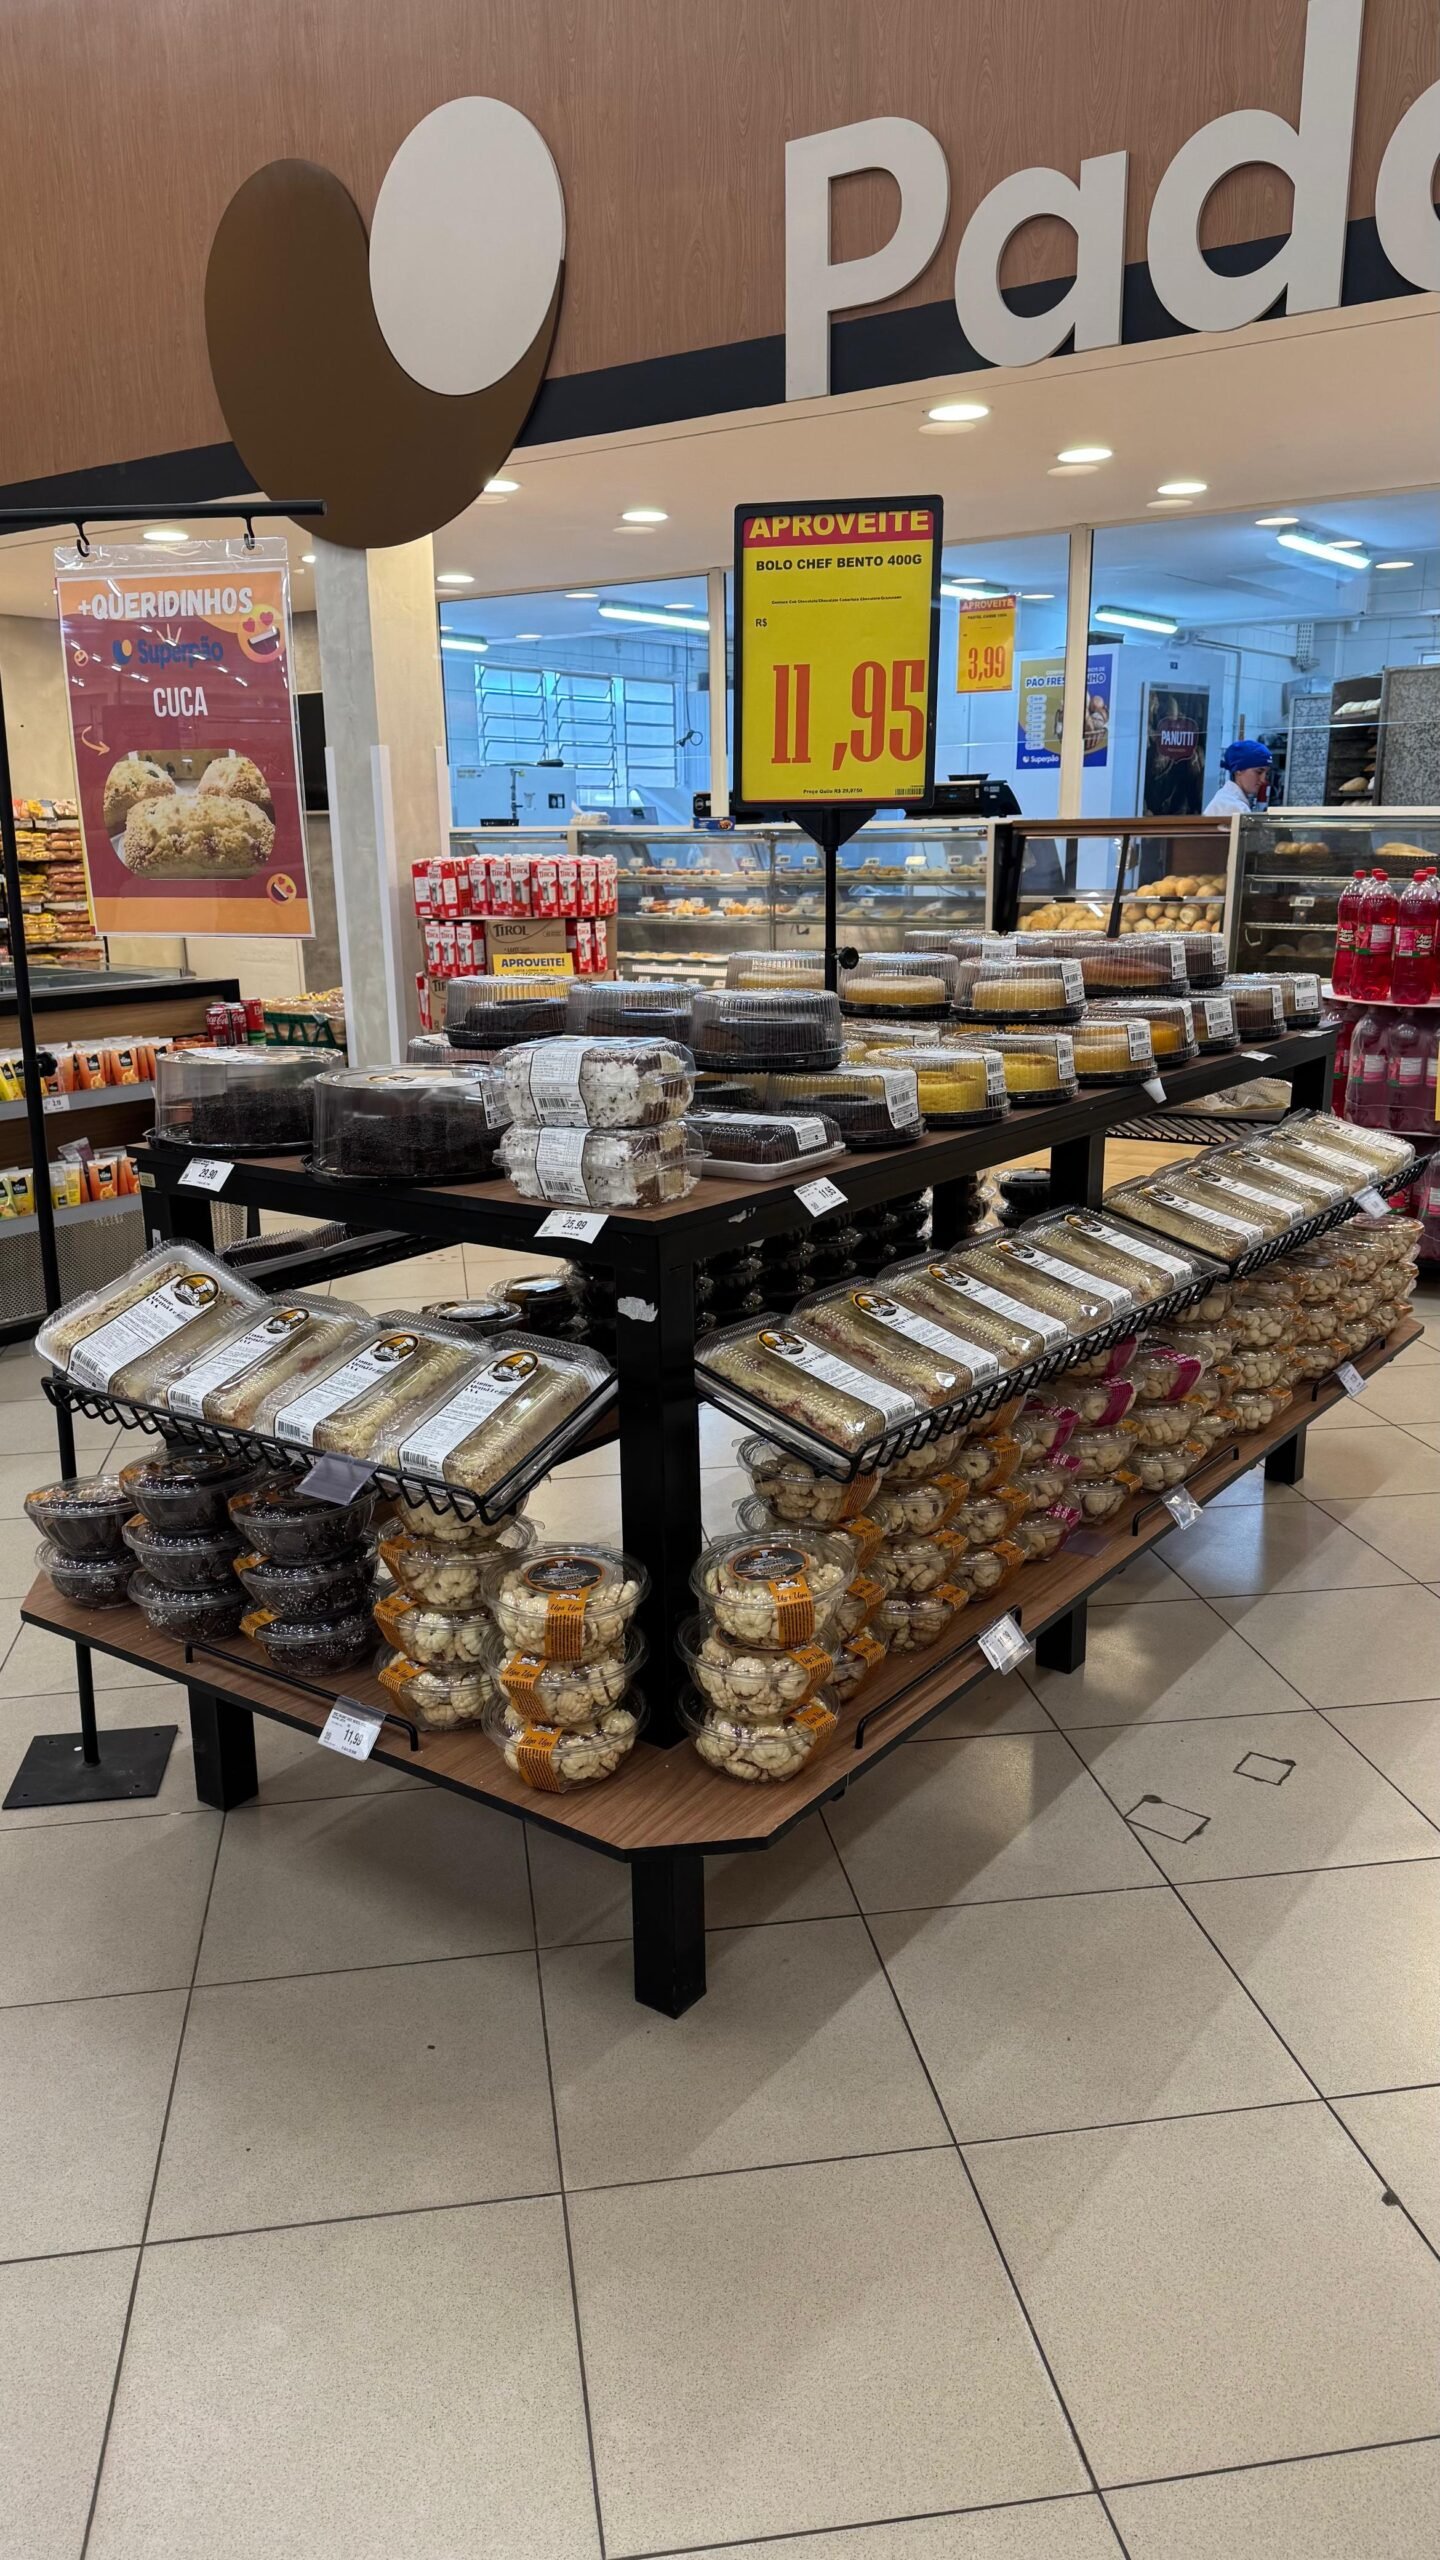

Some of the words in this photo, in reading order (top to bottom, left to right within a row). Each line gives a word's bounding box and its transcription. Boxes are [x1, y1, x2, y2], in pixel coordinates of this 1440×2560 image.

[749, 509, 929, 539] APROVEITE
[756, 559, 793, 571] BOLO
[797, 557, 833, 569] CHEF
[836, 555, 884, 567] BENTO
[887, 553, 923, 566] 400G
[960, 597, 1015, 611] APROVEITE
[755, 618, 767, 628] R$
[136, 636, 224, 669] Superpão
[968, 645, 1006, 682] 3,99
[153, 686, 209, 718] CUCA
[1160, 730, 1195, 746] PANUTTI
[492, 923, 530, 938] TIROL
[501, 957, 566, 968] APROVEITE!
[562, 1219, 588, 1230] 25,99
